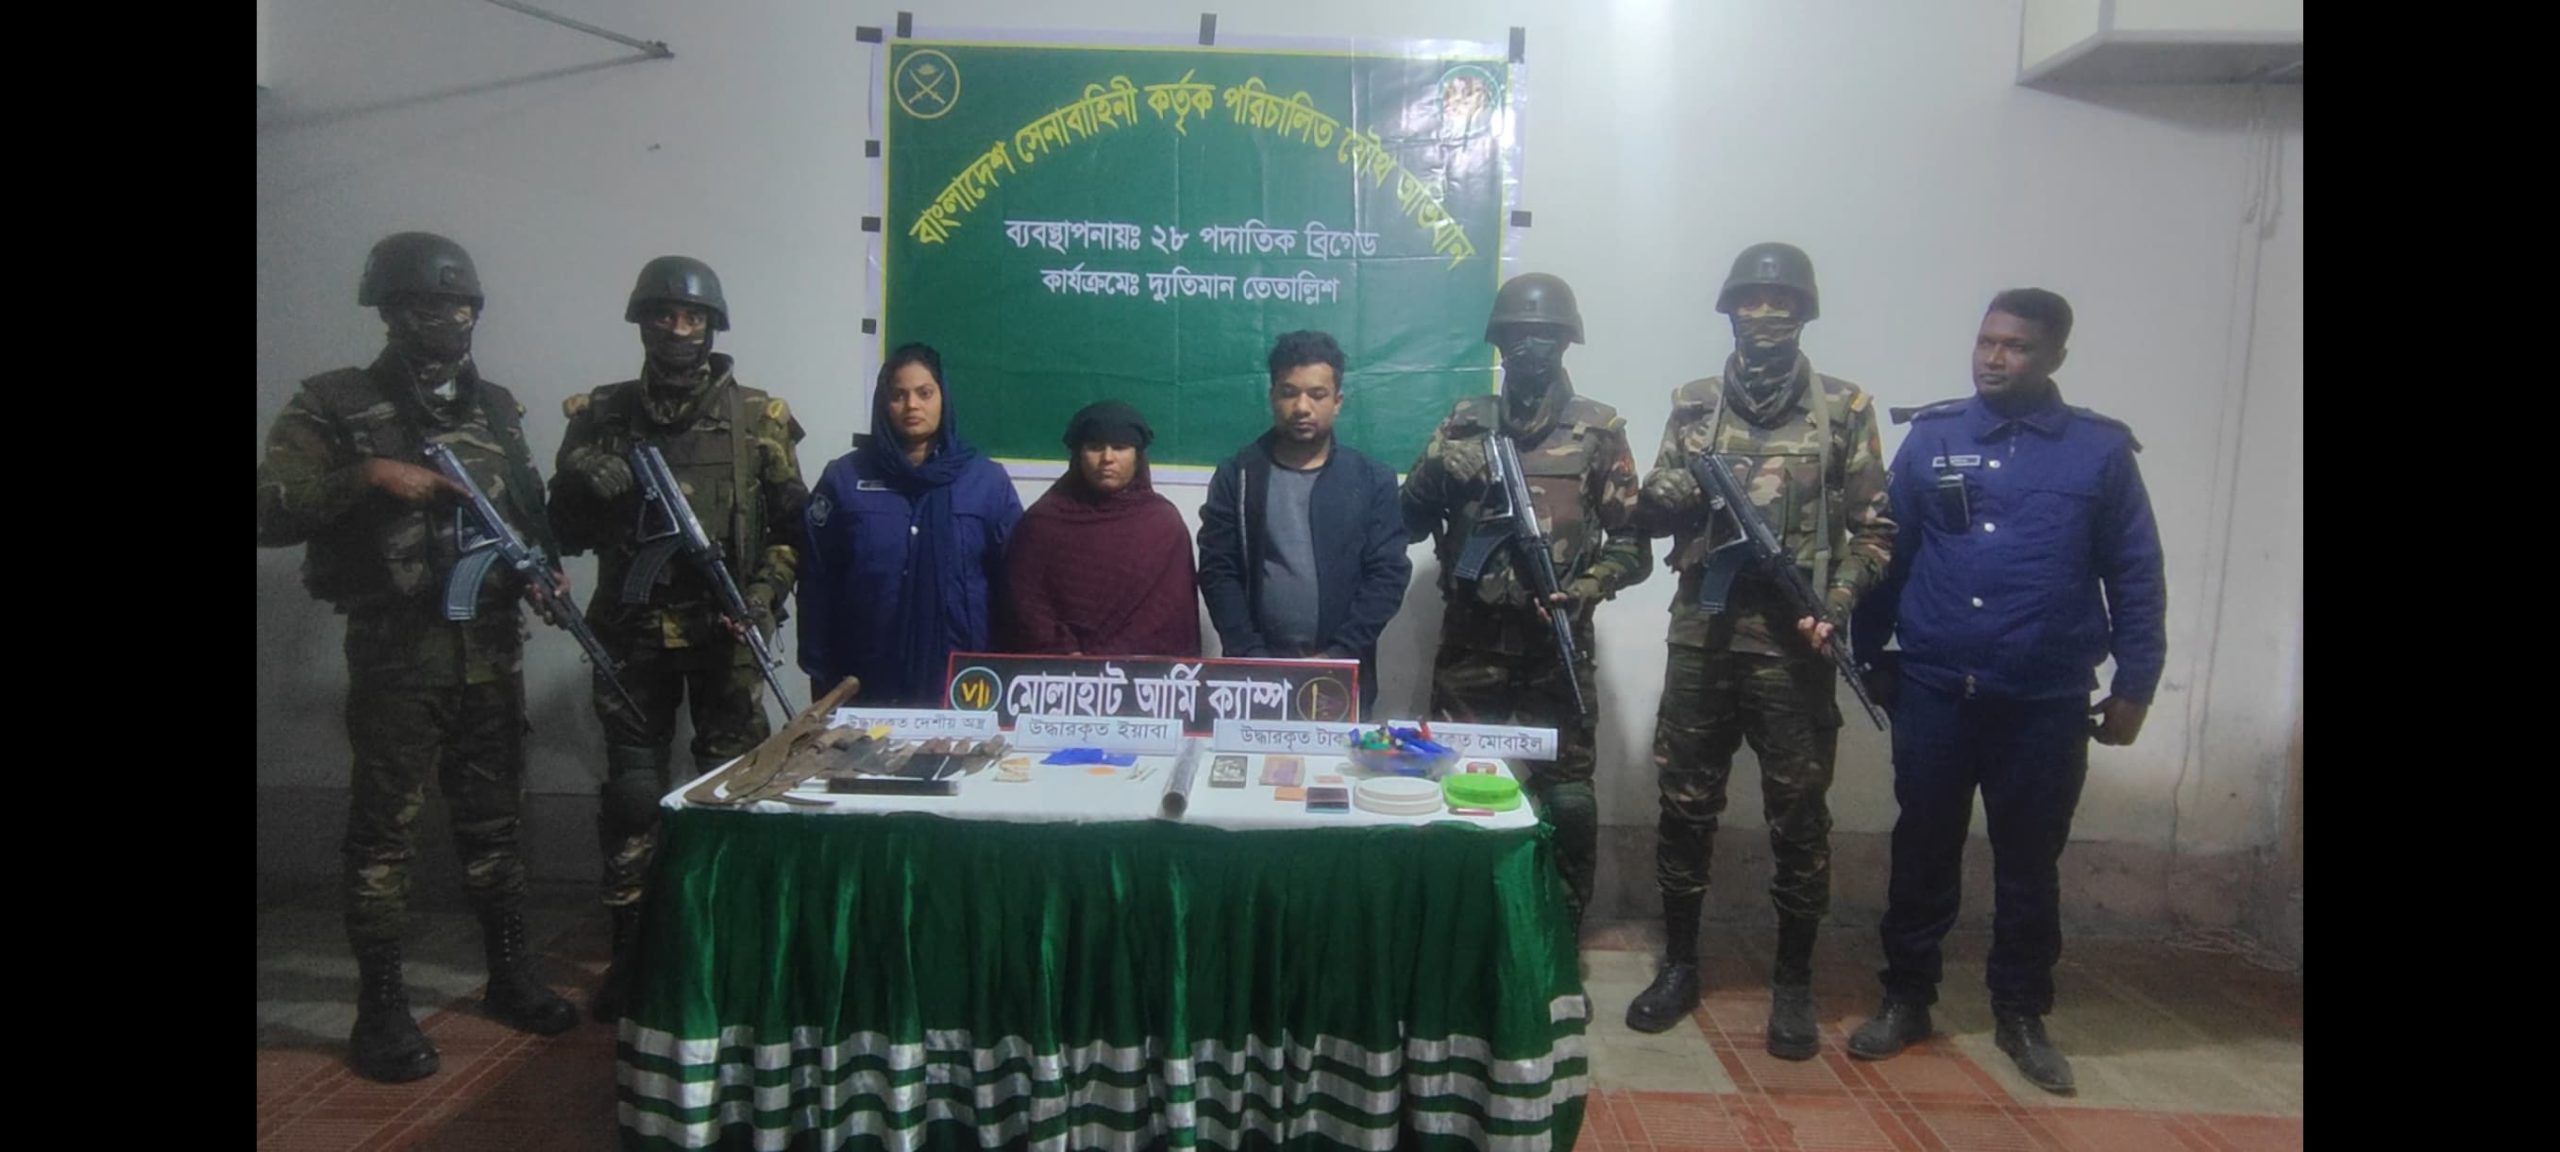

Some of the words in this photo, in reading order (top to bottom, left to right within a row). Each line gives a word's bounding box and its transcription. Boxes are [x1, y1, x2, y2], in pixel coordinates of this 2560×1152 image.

[909, 141, 1016, 245] বাংলাদেশ
[1015, 75, 1138, 163] সেনাবাহিনী
[1144, 68, 1217, 136] কর্তৃক
[1223, 76, 1340, 148] পরিচালিত
[1338, 125, 1397, 188] যৌথ
[1151, 225, 1190, 254] ২৮
[1199, 218, 1298, 256] পদাতিক
[1304, 221, 1380, 261] ব্রিগেড
[1146, 266, 1237, 303] দ্যুতিমান
[1242, 268, 1340, 305] তেতাল্লিশ
[1006, 661, 1130, 717] মোল্লাহাট
[1134, 663, 1203, 722] আর্মি
[1207, 675, 1294, 720] ক্যাম্প
[1028, 718, 1111, 742] উদ্ধারকৃত
[1117, 720, 1168, 740] ইয়াবা
[1240, 724, 1311, 750] উদ্ধারকৃত
[1478, 732, 1543, 753] মোবাইল
